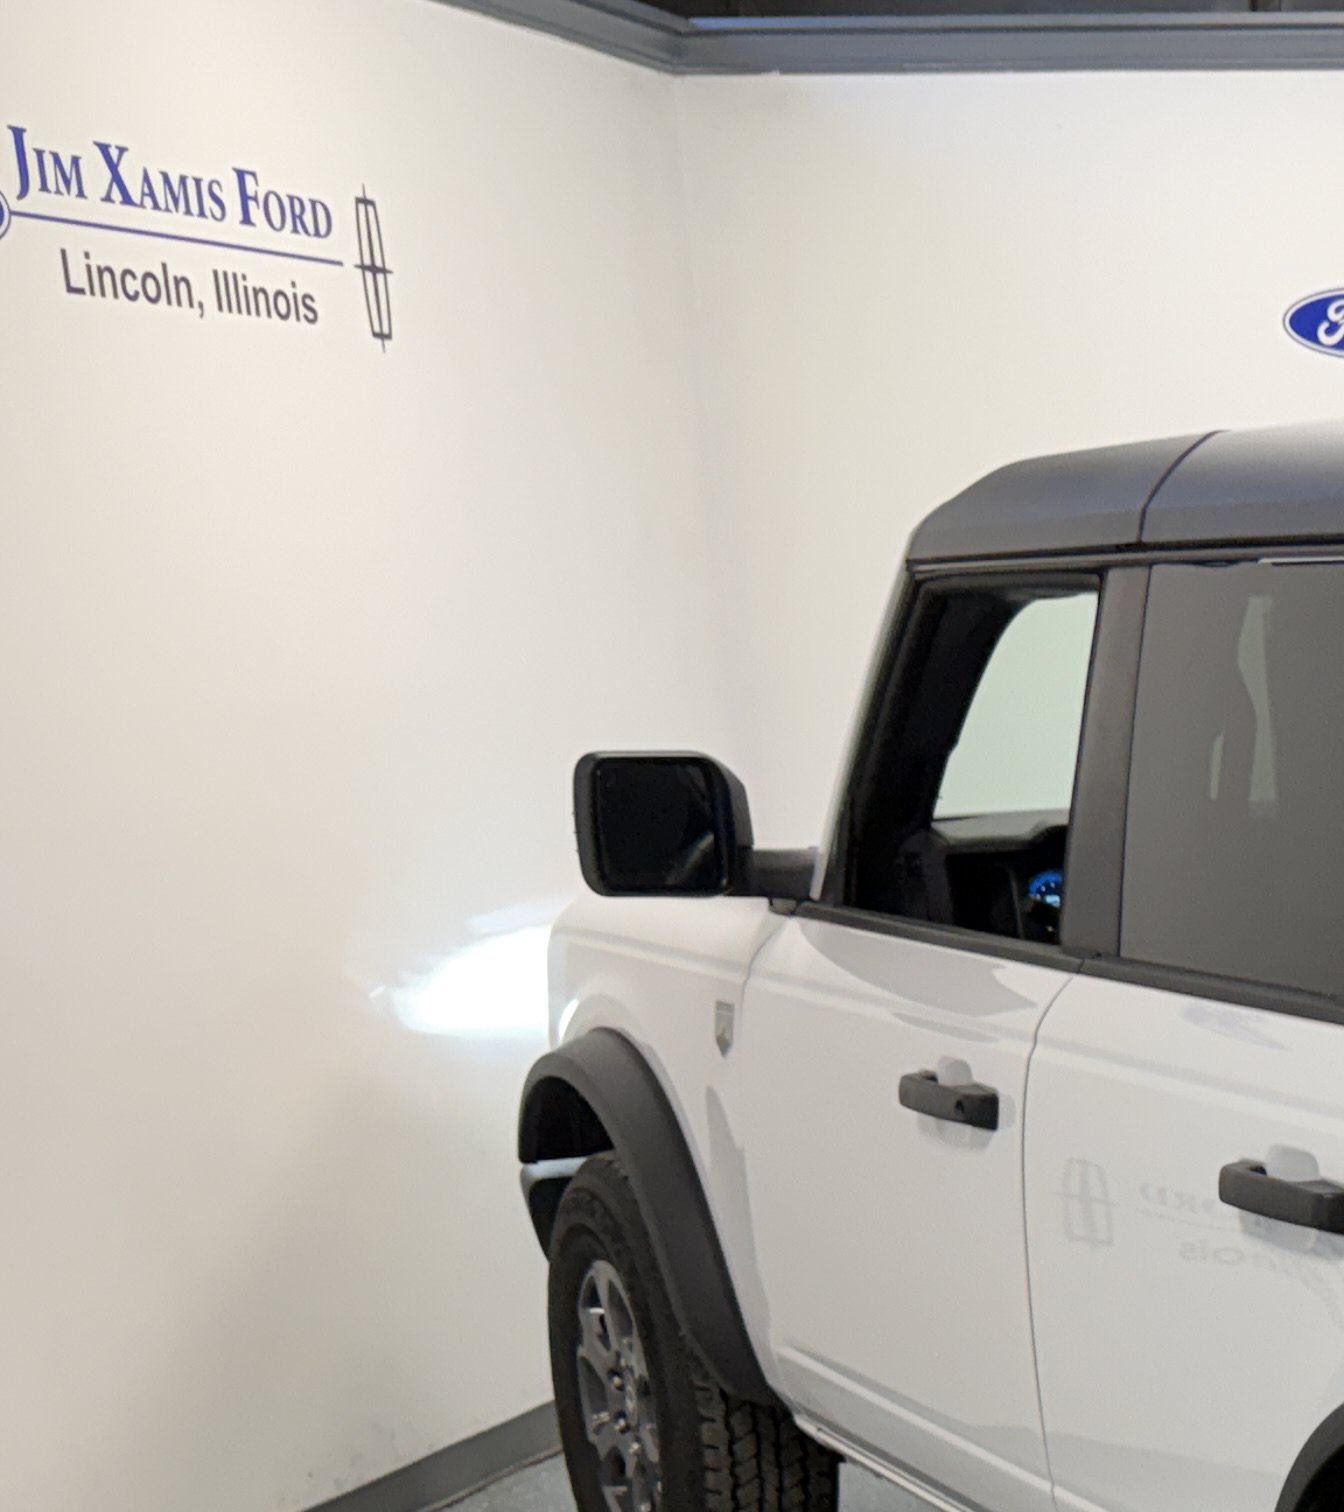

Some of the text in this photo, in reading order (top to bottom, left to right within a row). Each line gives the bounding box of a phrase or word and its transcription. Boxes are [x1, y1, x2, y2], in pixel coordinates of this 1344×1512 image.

[7, 124, 333, 239] JIM XAMIS FORD
[60, 248, 319, 325] Lincoln, Illinois
